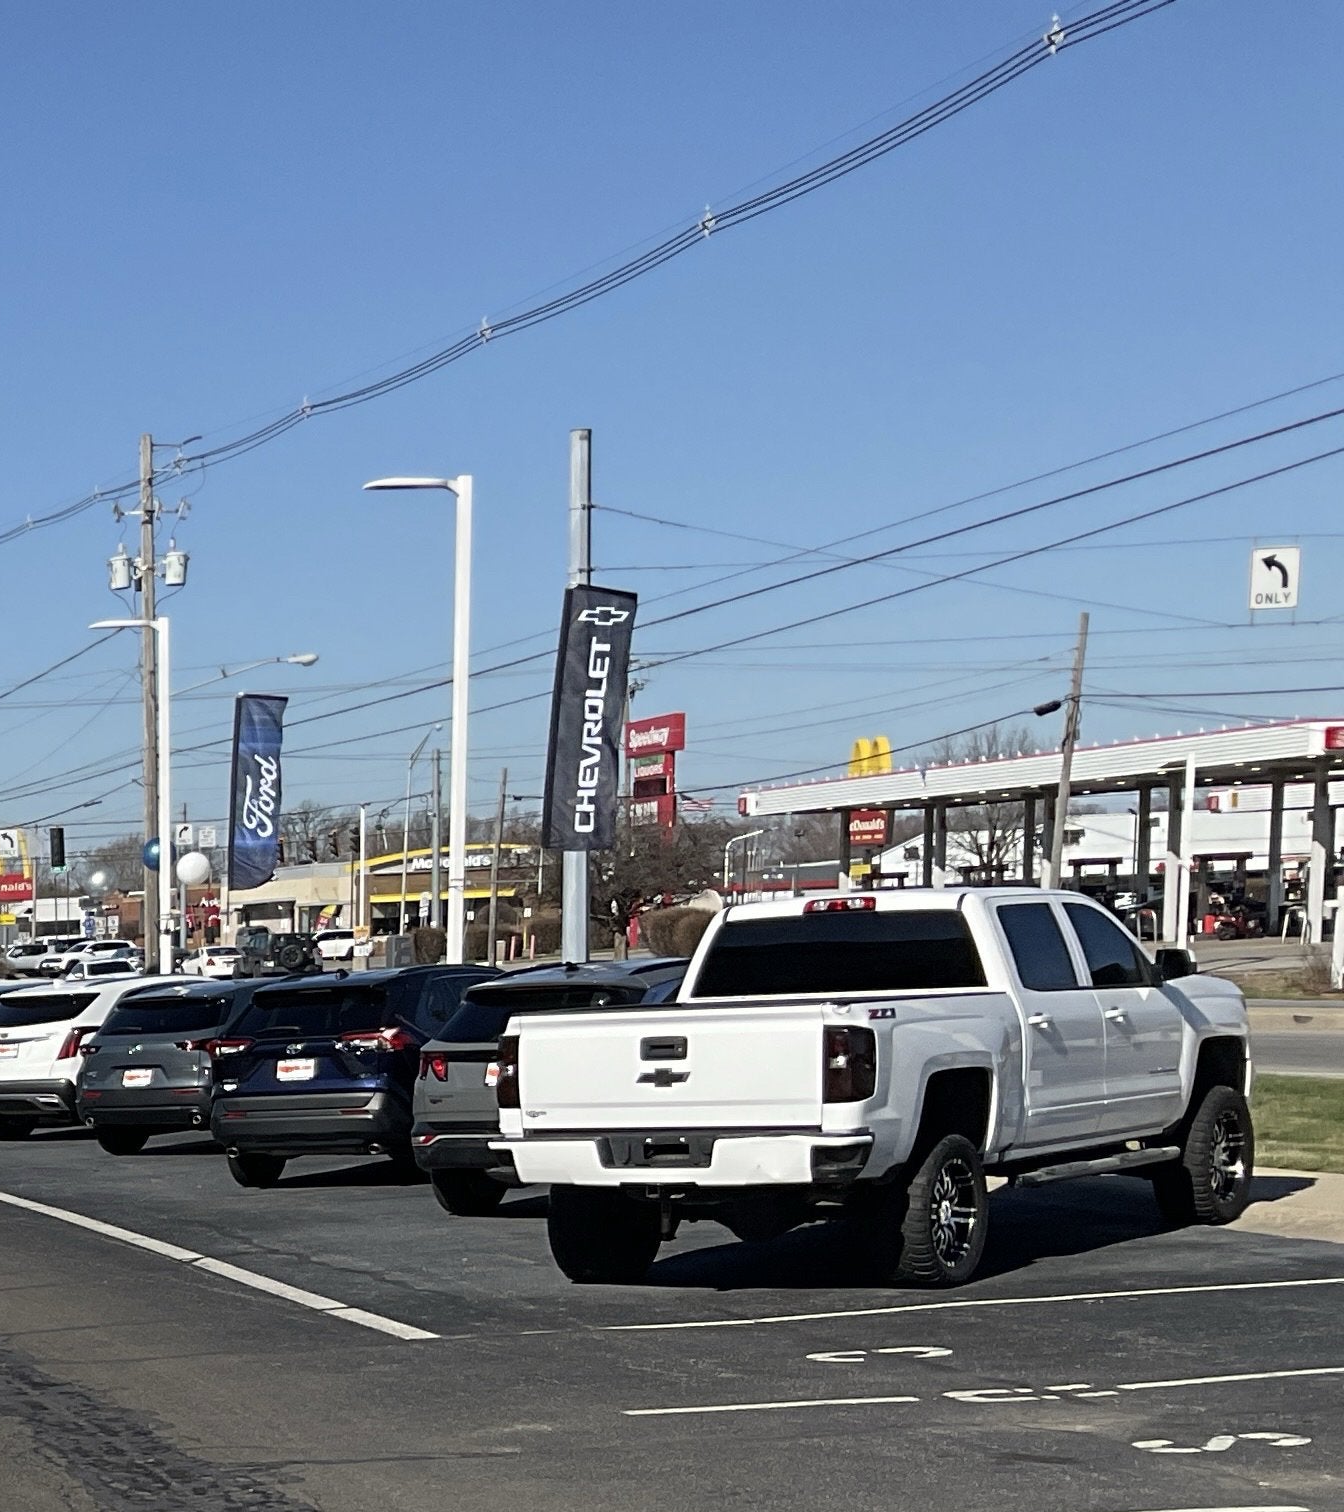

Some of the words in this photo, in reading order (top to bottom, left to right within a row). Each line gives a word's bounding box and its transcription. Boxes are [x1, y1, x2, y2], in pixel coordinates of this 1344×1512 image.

[1255, 591, 1292, 605] ONLY
[574, 636, 611, 833] CHEVROLET
[628, 726, 670, 752] Speedway
[635, 763, 664, 777] LIQUORS
[242, 754, 278, 838] Ford
